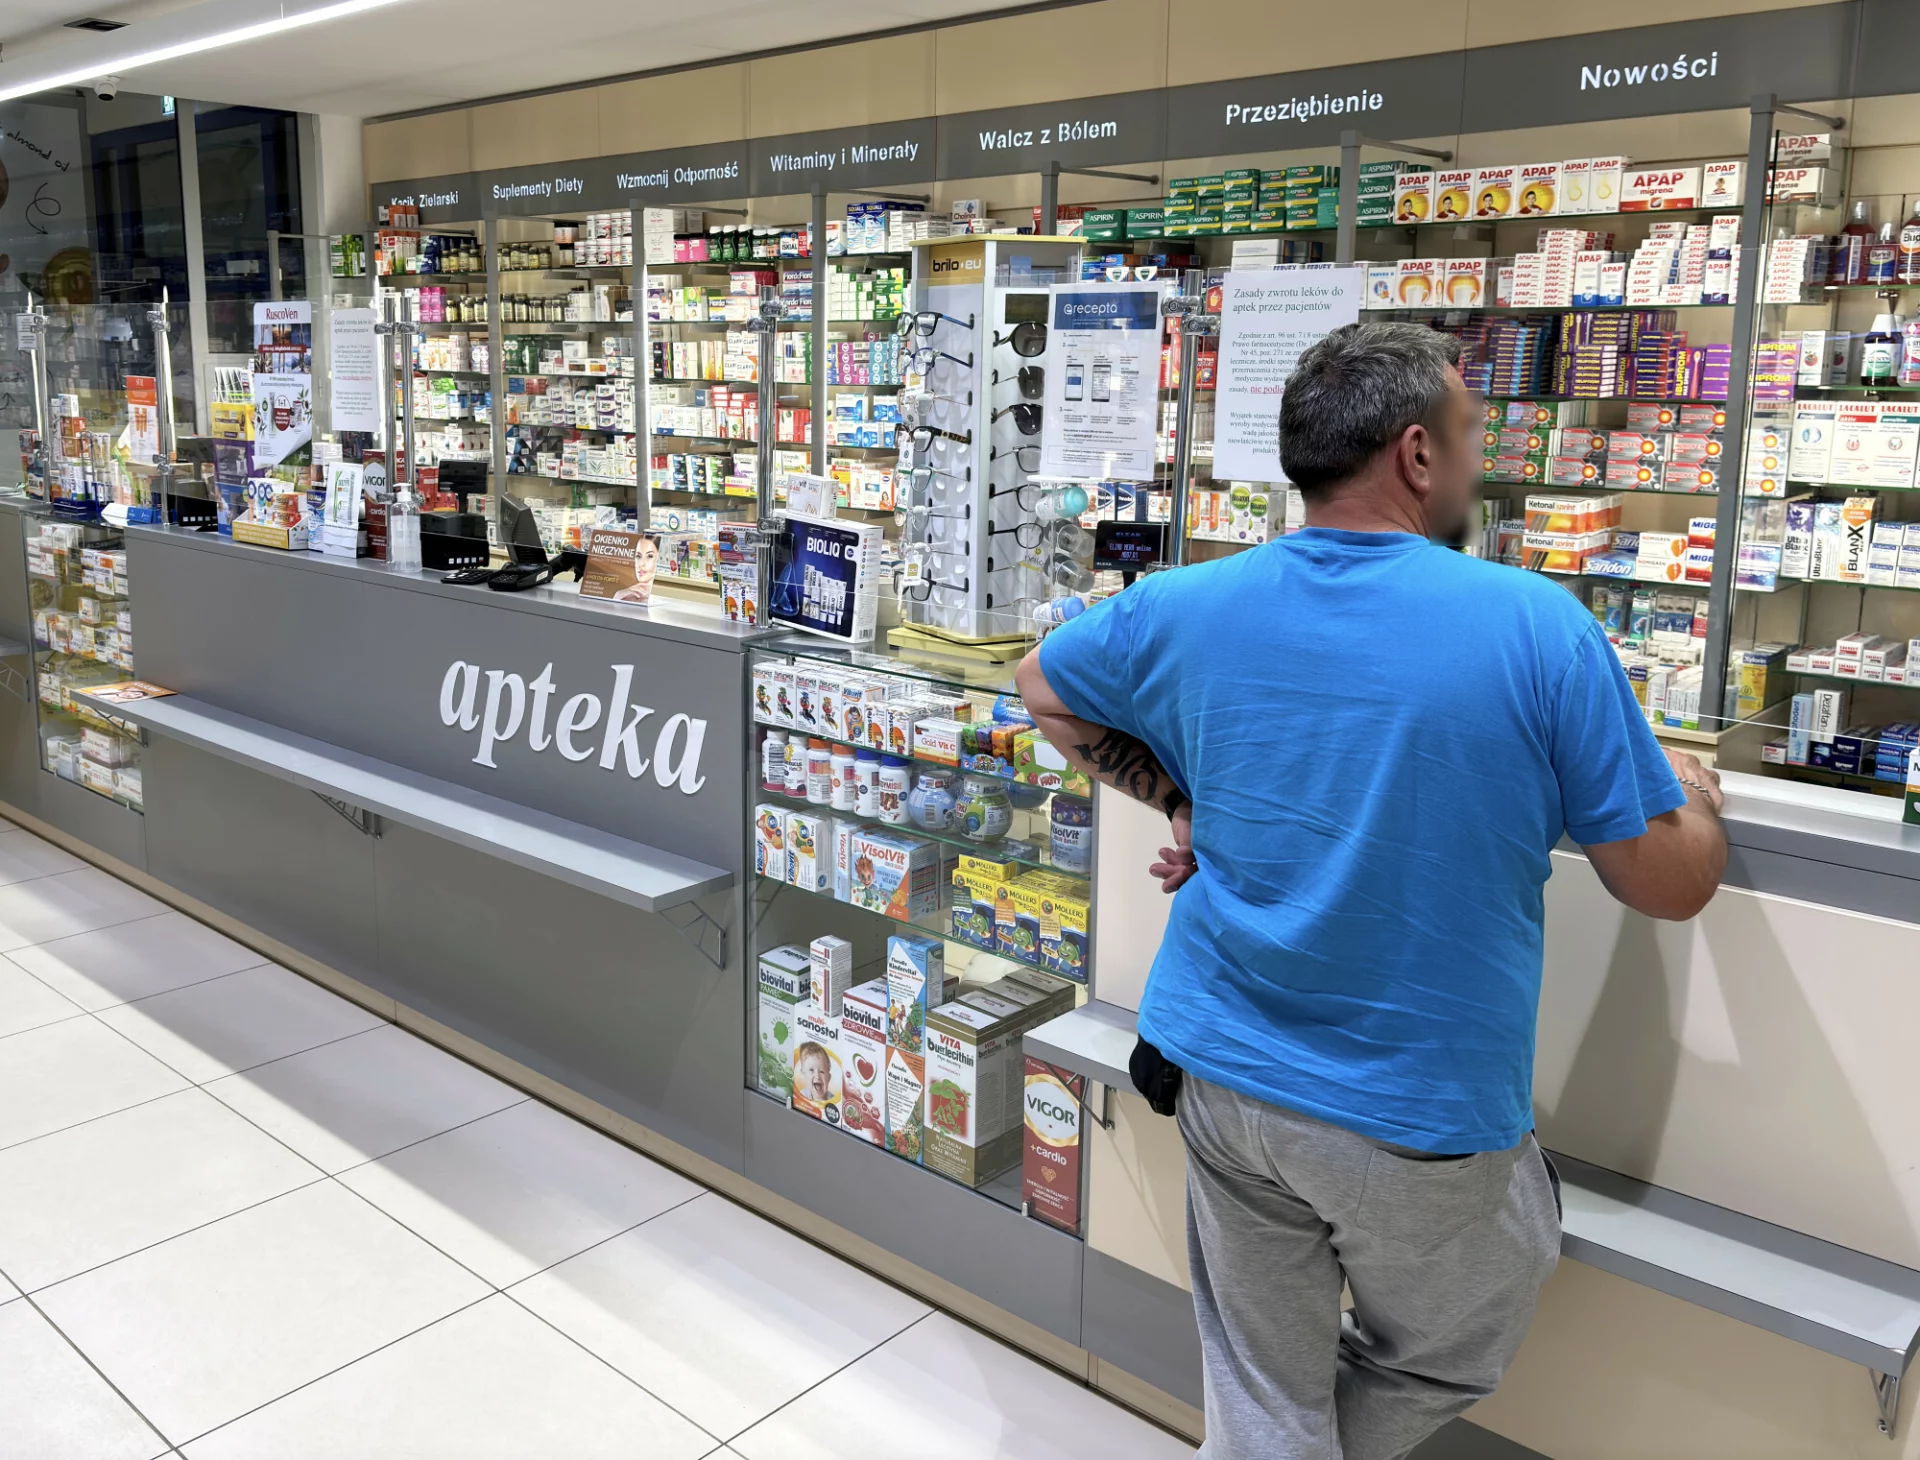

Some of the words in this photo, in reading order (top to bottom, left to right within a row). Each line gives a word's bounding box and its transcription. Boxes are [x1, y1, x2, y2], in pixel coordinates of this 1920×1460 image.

[1580, 52, 1718, 91] Nowości
[1226, 90, 1383, 125] Przeziębienie
[980, 129, 1033, 151] Walcz
[1040, 129, 1051, 145] z
[1058, 121, 1118, 142] Bólem
[1778, 136, 1818, 149] APAP
[7, 130, 53, 161] almond
[770, 152, 836, 173] Witaminy
[841, 148, 846, 165] i
[851, 140, 919, 164] Minerały
[1368, 164, 1394, 172] ASPIRIN
[1564, 162, 1589, 170] APAP
[1593, 160, 1618, 168] APAP
[1707, 164, 1736, 173] APAP
[617, 169, 670, 189] Wzmocnij
[674, 161, 739, 186] Odporność
[1439, 172, 1472, 183] APAP
[1479, 169, 1513, 180] APAP
[1521, 166, 1557, 177] APAP
[1399, 176, 1430, 186] APAP
[1633, 172, 1684, 187] APAP
[493, 179, 552, 201] Suplementy
[556, 178, 584, 196] Diety
[1640, 187, 1674, 195] migrena
[419, 191, 459, 208] Zielarski
[1090, 213, 1115, 222] ASPIRIN
[1134, 211, 1164, 220] ASPIRIN
[1401, 262, 1432, 270] APAP
[1449, 262, 1481, 270] APAP
[1577, 255, 1602, 263] APAP
[1234, 288, 1265, 300] Zasady
[1267, 289, 1299, 298] zwrotu
[1301, 287, 1328, 297] leków
[1331, 287, 1343, 296] do
[266, 307, 299, 321] RuscoVen
[1232, 302, 1256, 313] aptek
[1259, 304, 1282, 314] przez
[1285, 301, 1332, 313] pacjentów
[1561, 315, 1570, 352] IBUPROM
[1631, 314, 1640, 352] IBUPROM
[1559, 357, 1567, 394] IBUPROM
[1618, 357, 1627, 395] IBUPROM
[1797, 403, 1833, 411] LACALUT
[1839, 405, 1875, 413] LACALUT
[1881, 405, 1919, 413] LACALUT
[1528, 500, 1555, 510] Ketonal
[1556, 502, 1576, 512] sprint
[594, 534, 629, 546] OKIENKO
[806, 536, 841, 558] BIOLIQ
[1526, 536, 1554, 546] Ketonal
[1555, 539, 1575, 549] sprint
[592, 544, 635, 558] NIECZYNNE
[1847, 525, 1864, 572] BLANX
[1585, 560, 1632, 576] Saridon
[1823, 693, 1832, 729] Dezaftan
[440, 660, 707, 795] apteka
[921, 736, 936, 749] Gold
[938, 740, 950, 750] Vit
[949, 743, 956, 751] C
[861, 841, 906, 866] VisolVit
[888, 962, 917, 976] Kindervital
[760, 968, 794, 994] biovital
[843, 1003, 881, 1030] biovital
[797, 1015, 839, 1041] sanostol
[843, 1020, 875, 1037] ZDROWE
[940, 1034, 961, 1051] VITA
[1027, 1093, 1076, 1127] VIGOR
